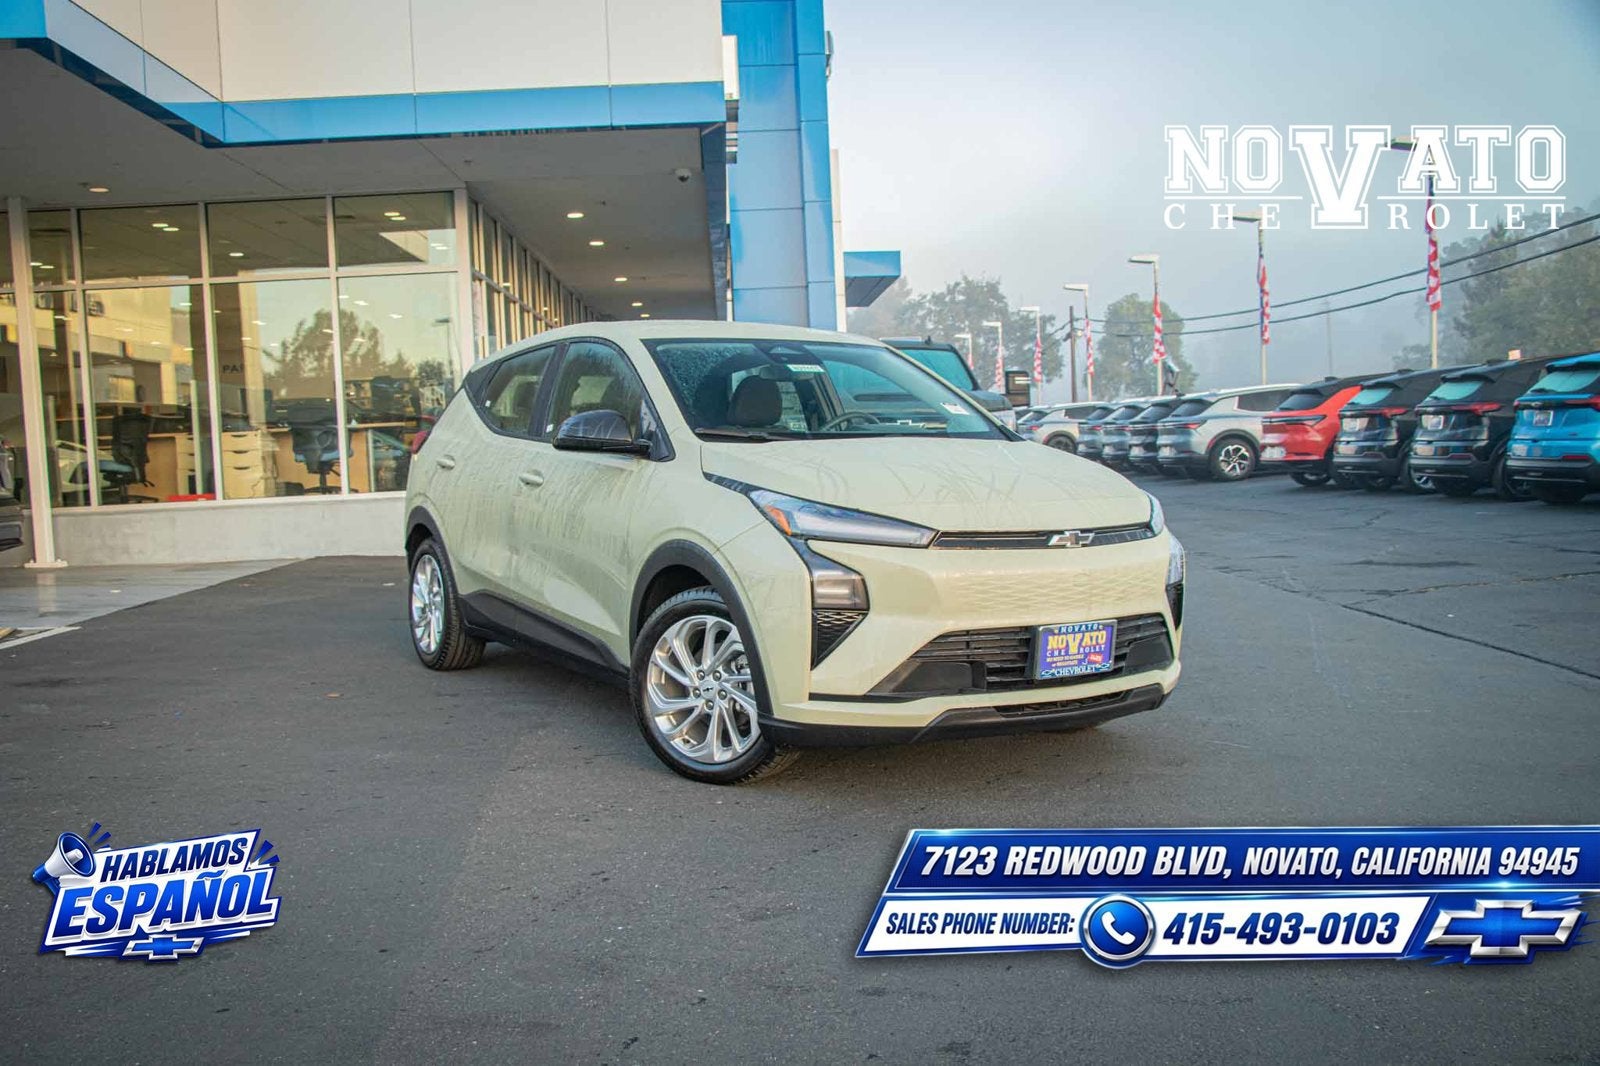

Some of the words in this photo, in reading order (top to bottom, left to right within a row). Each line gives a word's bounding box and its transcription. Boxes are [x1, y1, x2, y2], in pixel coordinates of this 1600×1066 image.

[1061, 623, 1098, 633] NOVATO
[1047, 630, 1107, 655] NOVATO
[1055, 664, 1096, 677] CHEVROLET
